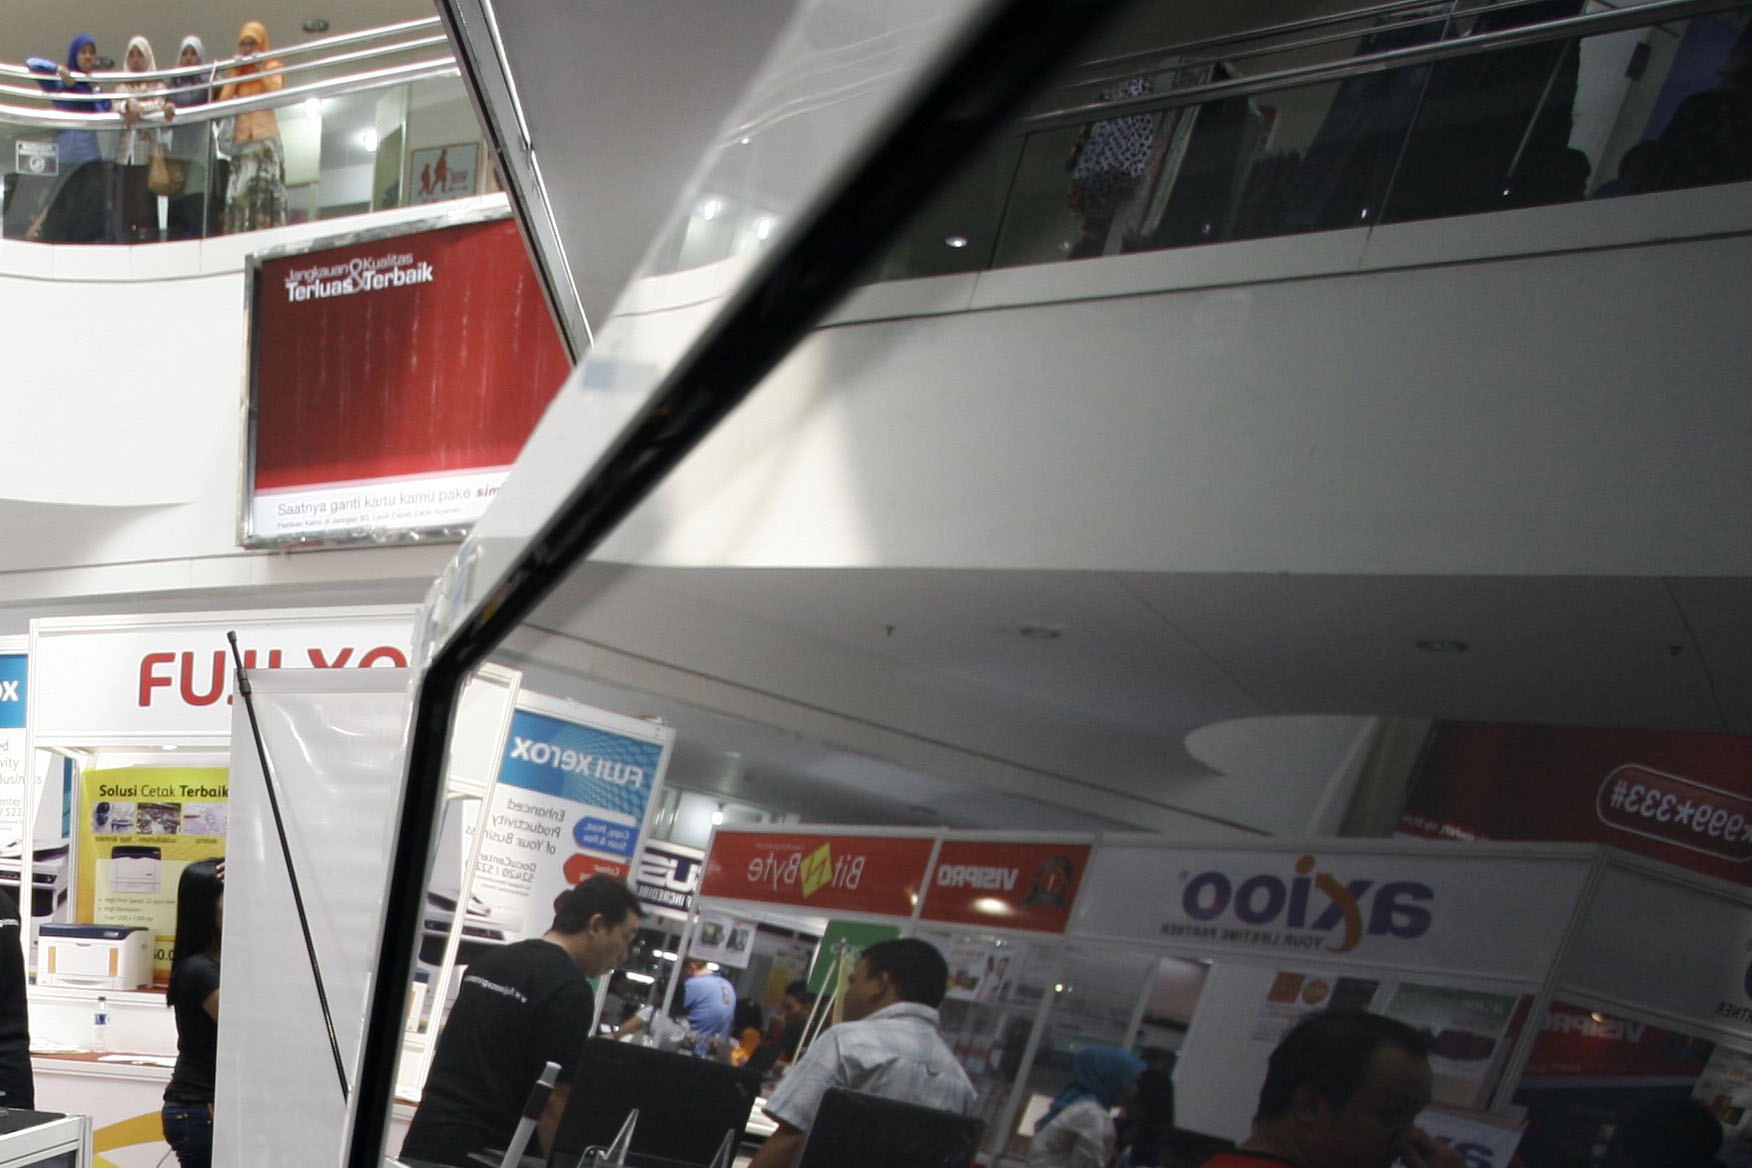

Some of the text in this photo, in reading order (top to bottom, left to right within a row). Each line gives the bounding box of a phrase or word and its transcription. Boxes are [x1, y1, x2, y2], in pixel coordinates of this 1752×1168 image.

[285, 264, 349, 284] Jangkauan
[363, 252, 413, 271] Kualitas
[285, 261, 434, 302] Terluas Terbaik
[278, 488, 471, 517] Saatnya ganti kartu kamu pake
[99, 784, 229, 798] Solusi Cetak Terbaik
